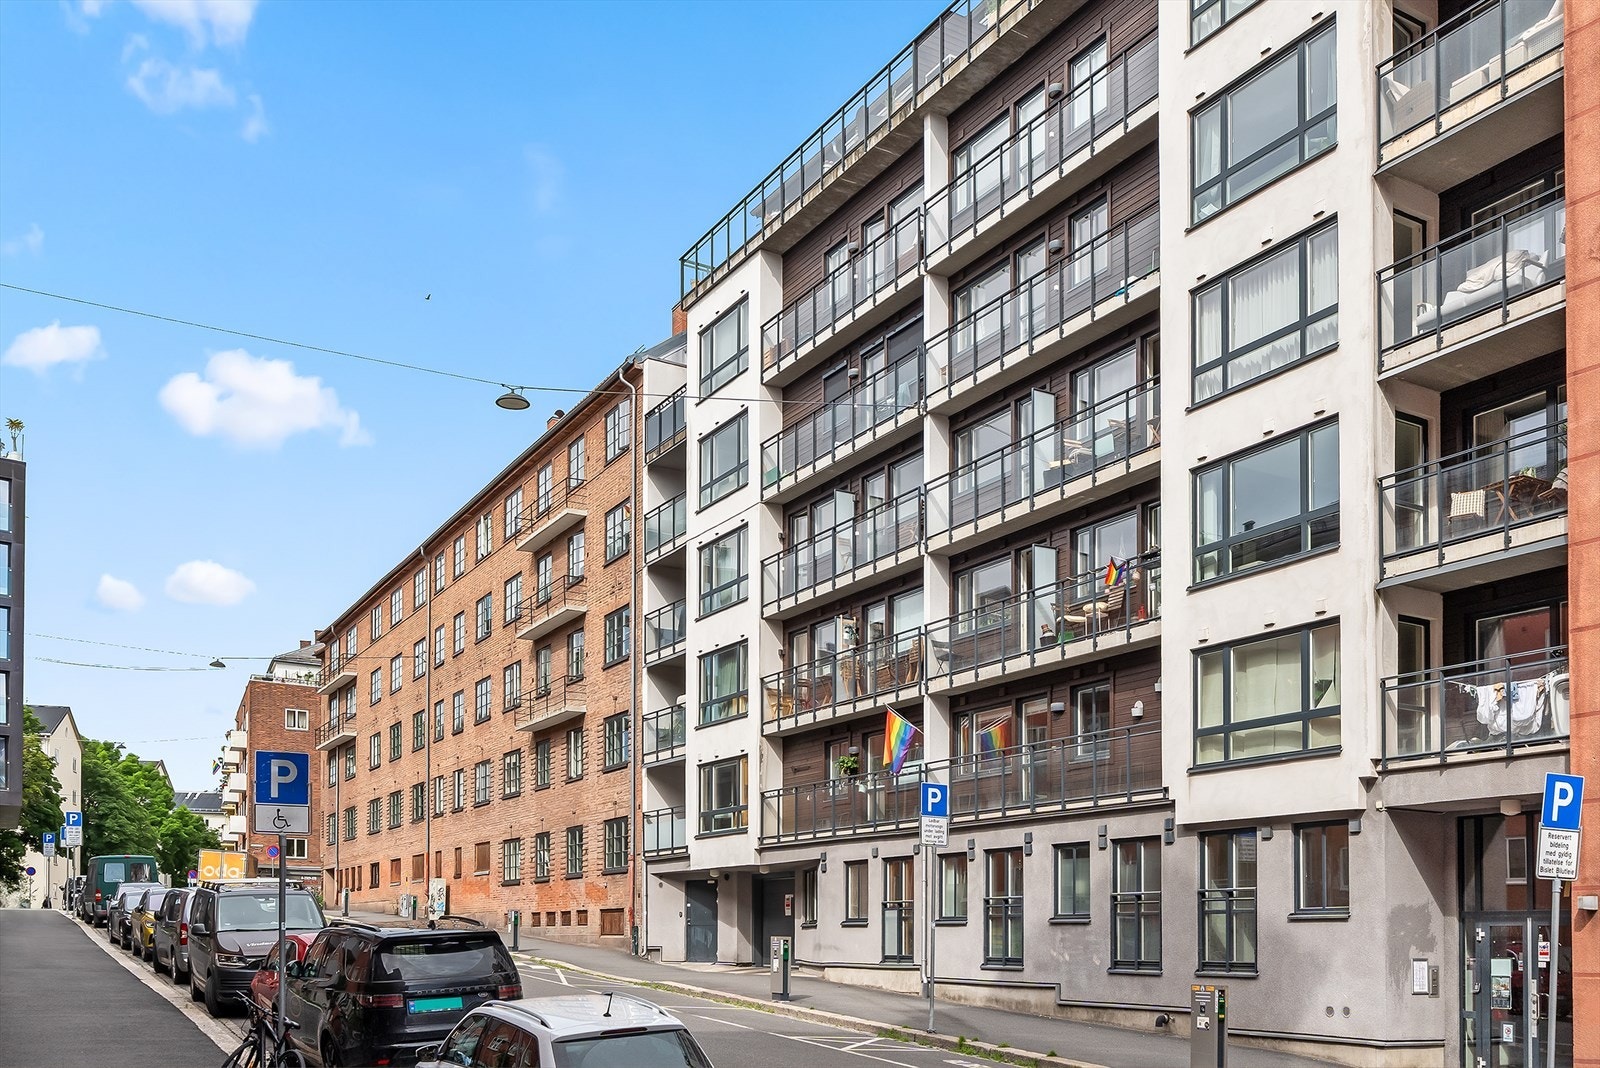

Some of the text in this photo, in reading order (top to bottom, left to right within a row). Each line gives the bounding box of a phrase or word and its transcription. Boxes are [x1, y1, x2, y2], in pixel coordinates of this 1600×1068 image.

[270, 759, 298, 798] P
[927, 787, 942, 812] P
[1551, 781, 1574, 821] P
[69, 814, 78, 825] P
[45, 834, 53, 842] P
[1547, 832, 1572, 840] Reservert
[1557, 851, 1572, 859] gyldig
[1542, 858, 1563, 866] tillatelse
[203, 864, 241, 878] oda
[1539, 866, 1554, 874] Bislet
